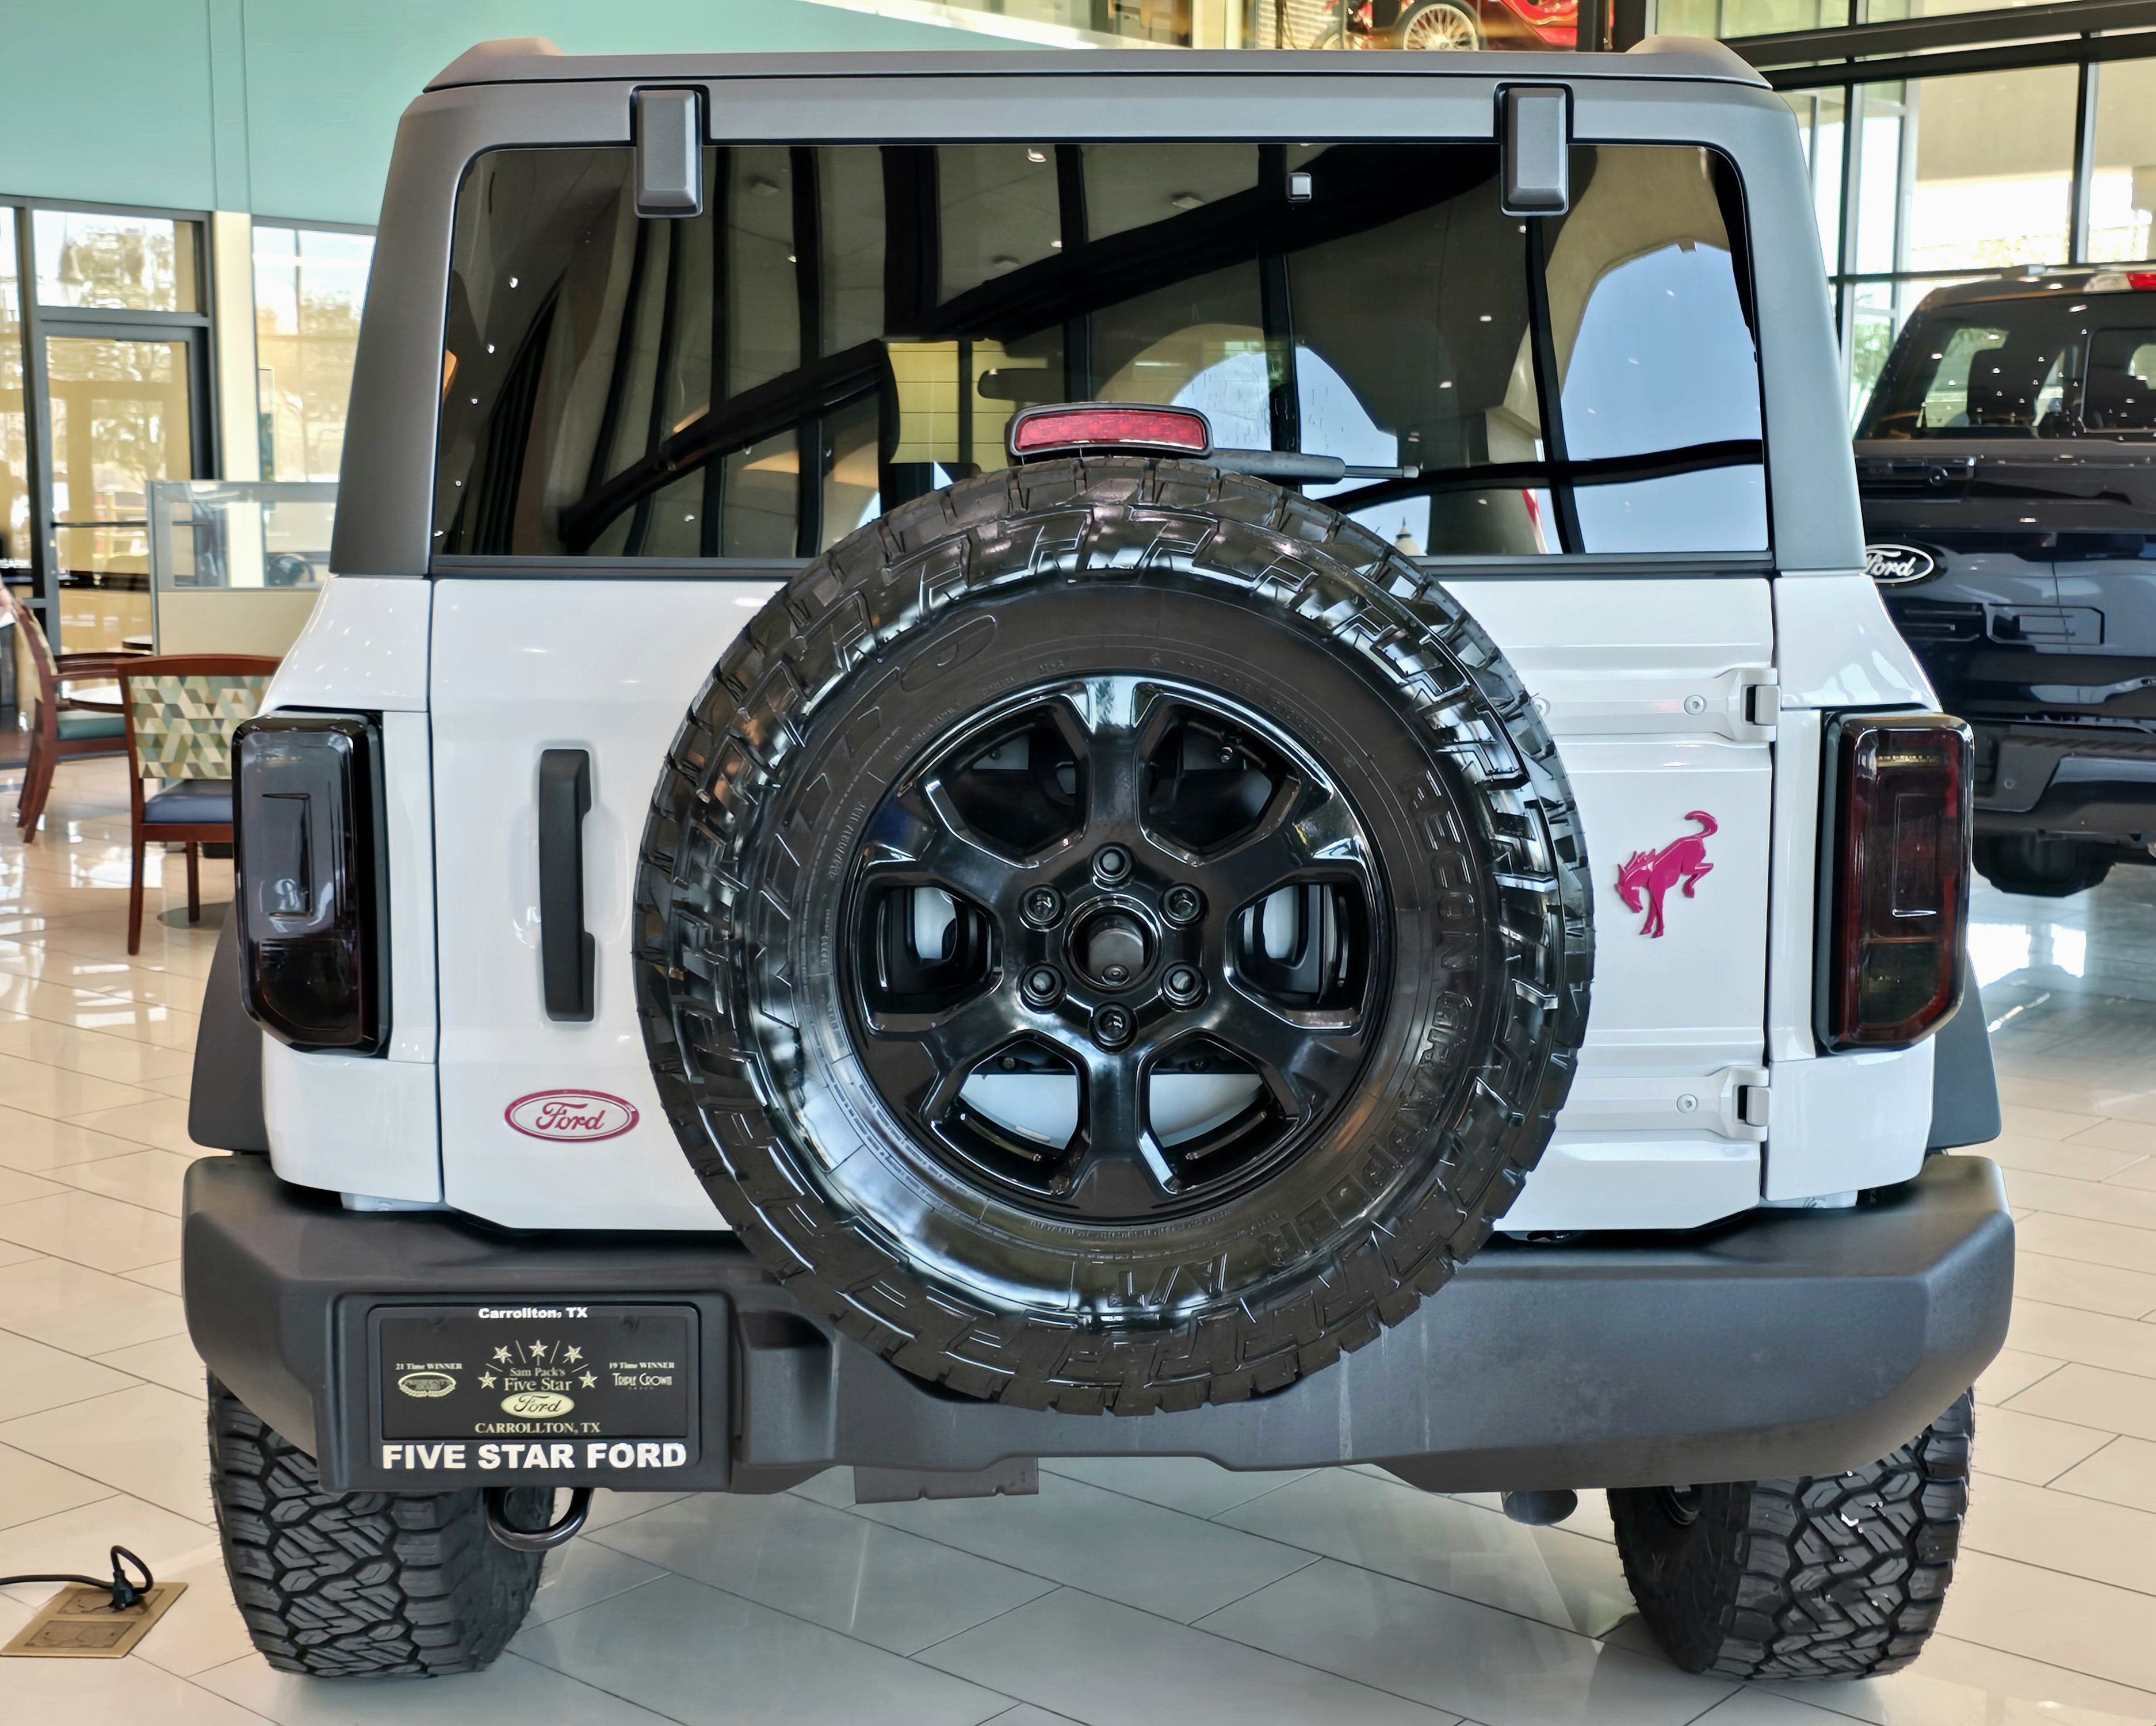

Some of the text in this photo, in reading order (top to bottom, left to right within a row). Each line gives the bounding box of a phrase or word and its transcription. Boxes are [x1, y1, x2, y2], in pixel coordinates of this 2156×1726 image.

[1399, 769, 1478, 971] RECON
[536, 1102, 605, 1129] Ford
[1258, 991, 1474, 1267] GRAPPLER
[1107, 1253, 1228, 1308] A/T
[479, 1307, 588, 1319] Carrollton, TX
[510, 1367, 532, 1376] Sam
[504, 1377, 572, 1391] Five Star
[514, 1394, 561, 1412] Ford
[475, 1422, 601, 1434] CARROLLTON, TX
[382, 1442, 687, 1469] FIVE STAR FORD
